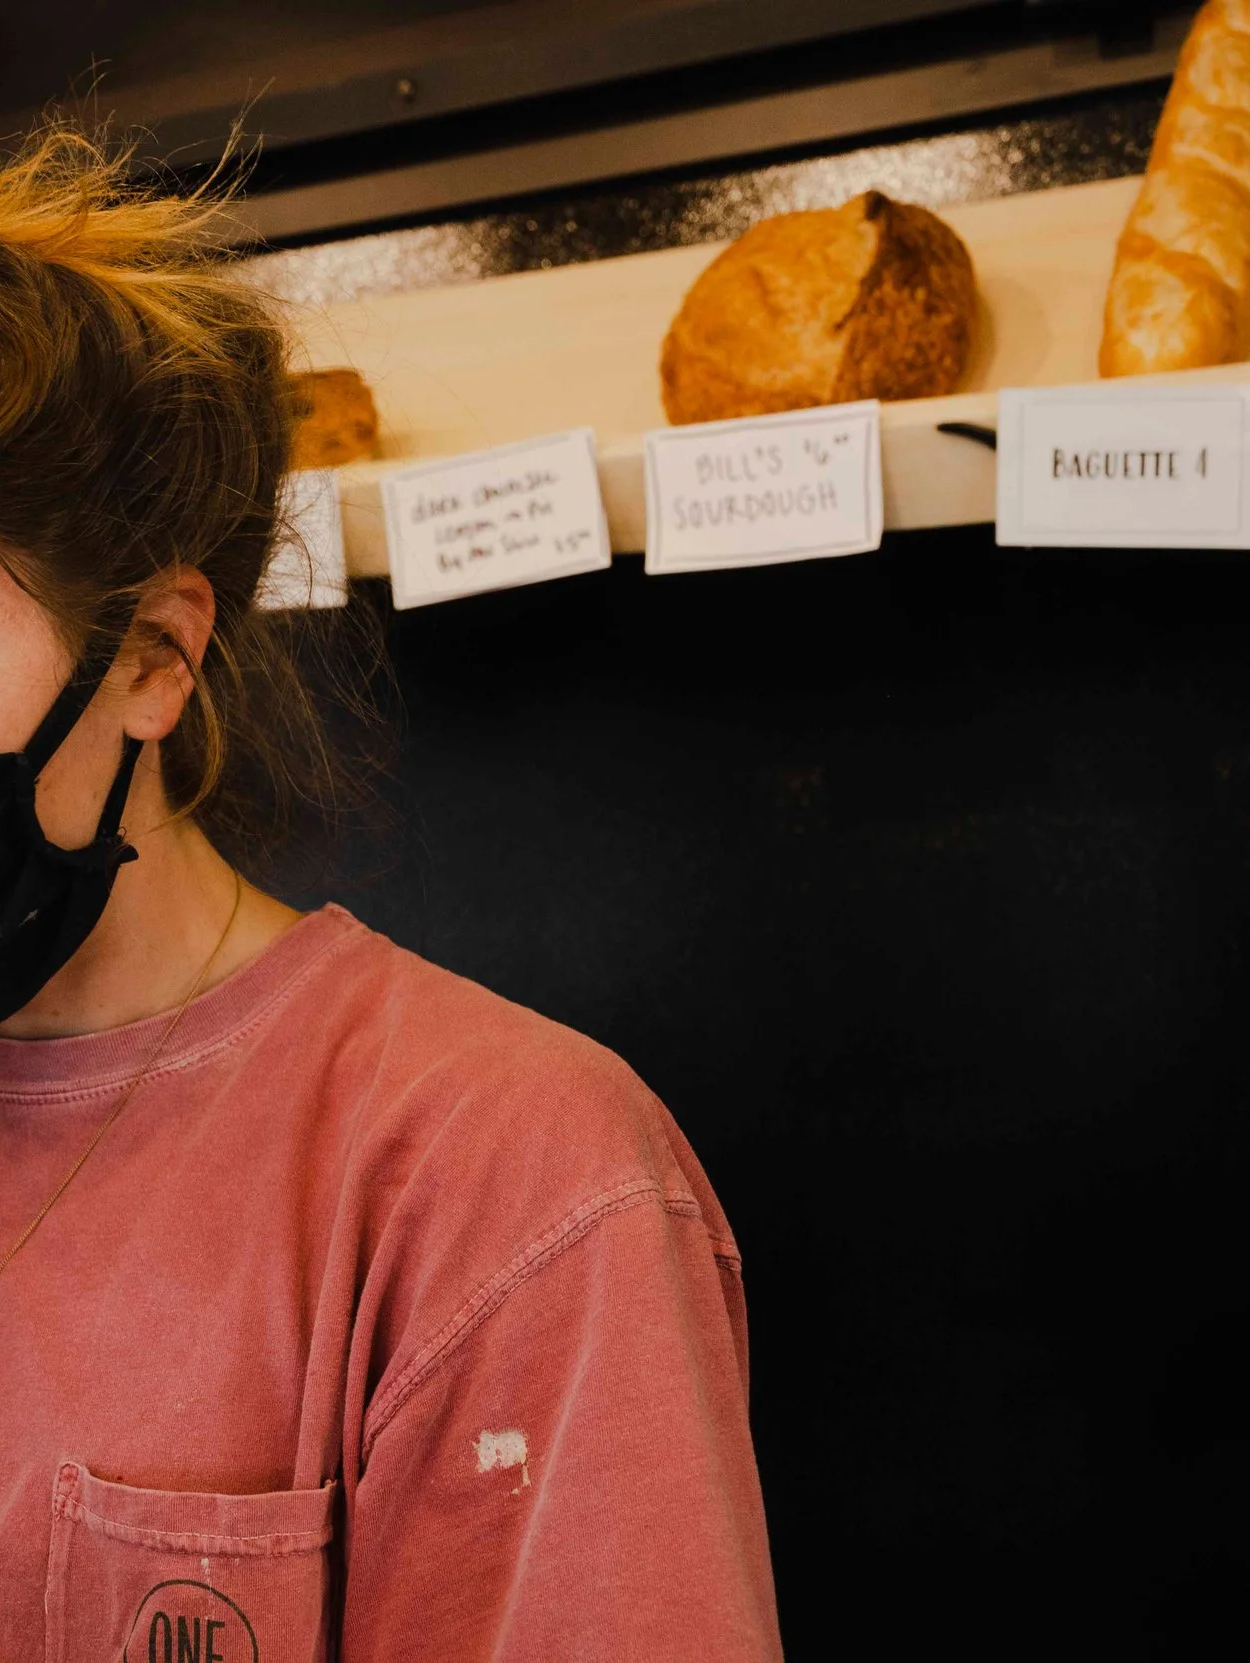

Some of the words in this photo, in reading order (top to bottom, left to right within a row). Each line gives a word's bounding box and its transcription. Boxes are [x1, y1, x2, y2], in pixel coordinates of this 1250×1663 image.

[1052, 448, 1180, 480] BAGUETTE
[673, 480, 839, 532] SOURDOUGH
[148, 1610, 226, 1663] ONE
